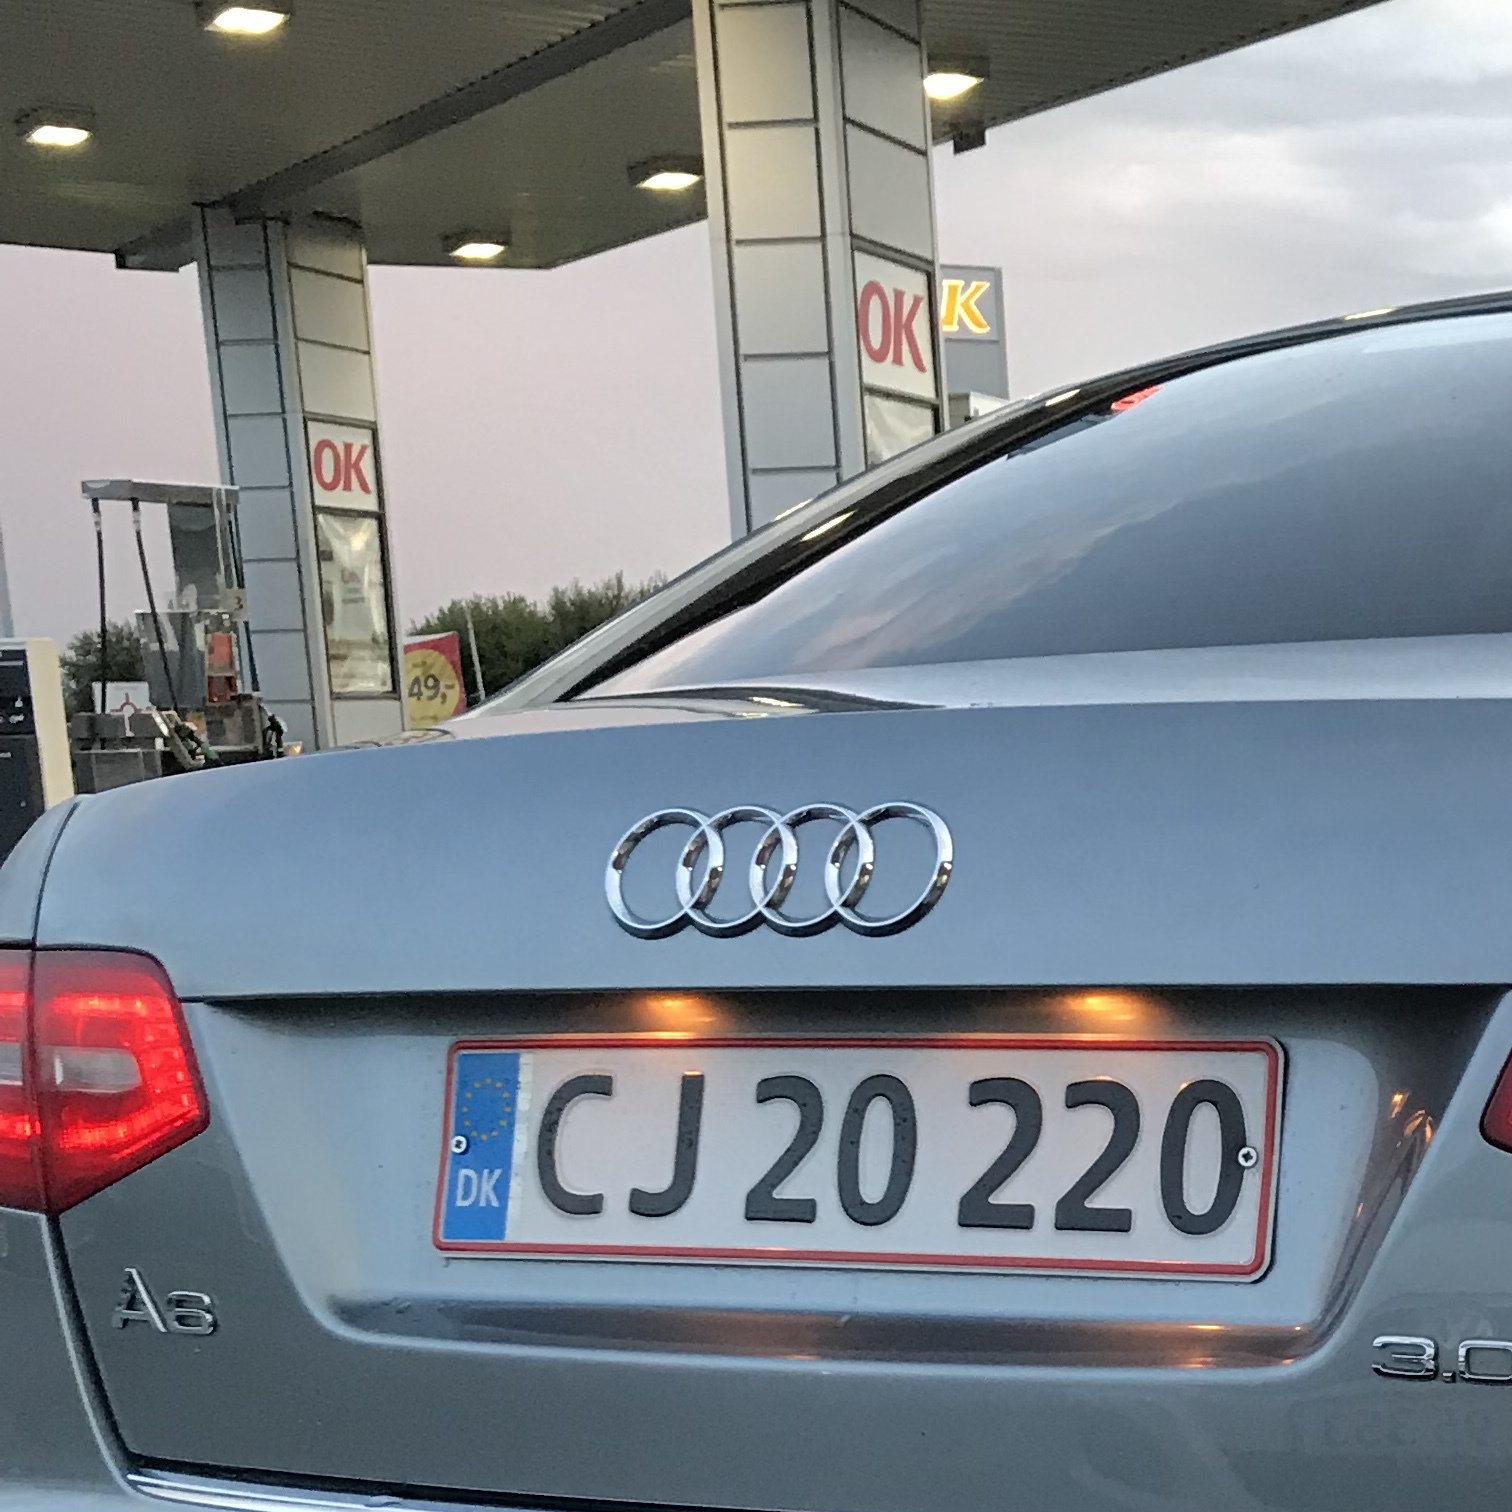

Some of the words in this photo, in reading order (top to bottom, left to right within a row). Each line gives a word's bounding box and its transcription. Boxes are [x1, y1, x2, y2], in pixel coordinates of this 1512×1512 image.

[858, 279, 927, 373] OK
[940, 279, 991, 334] K
[313, 439, 371, 494] OK
[537, 1069, 706, 1218] CJ
[744, 1073, 918, 1227] 20
[957, 1074, 1249, 1236] 220
[455, 1168, 503, 1208] DK
[111, 1266, 215, 1335] A6
